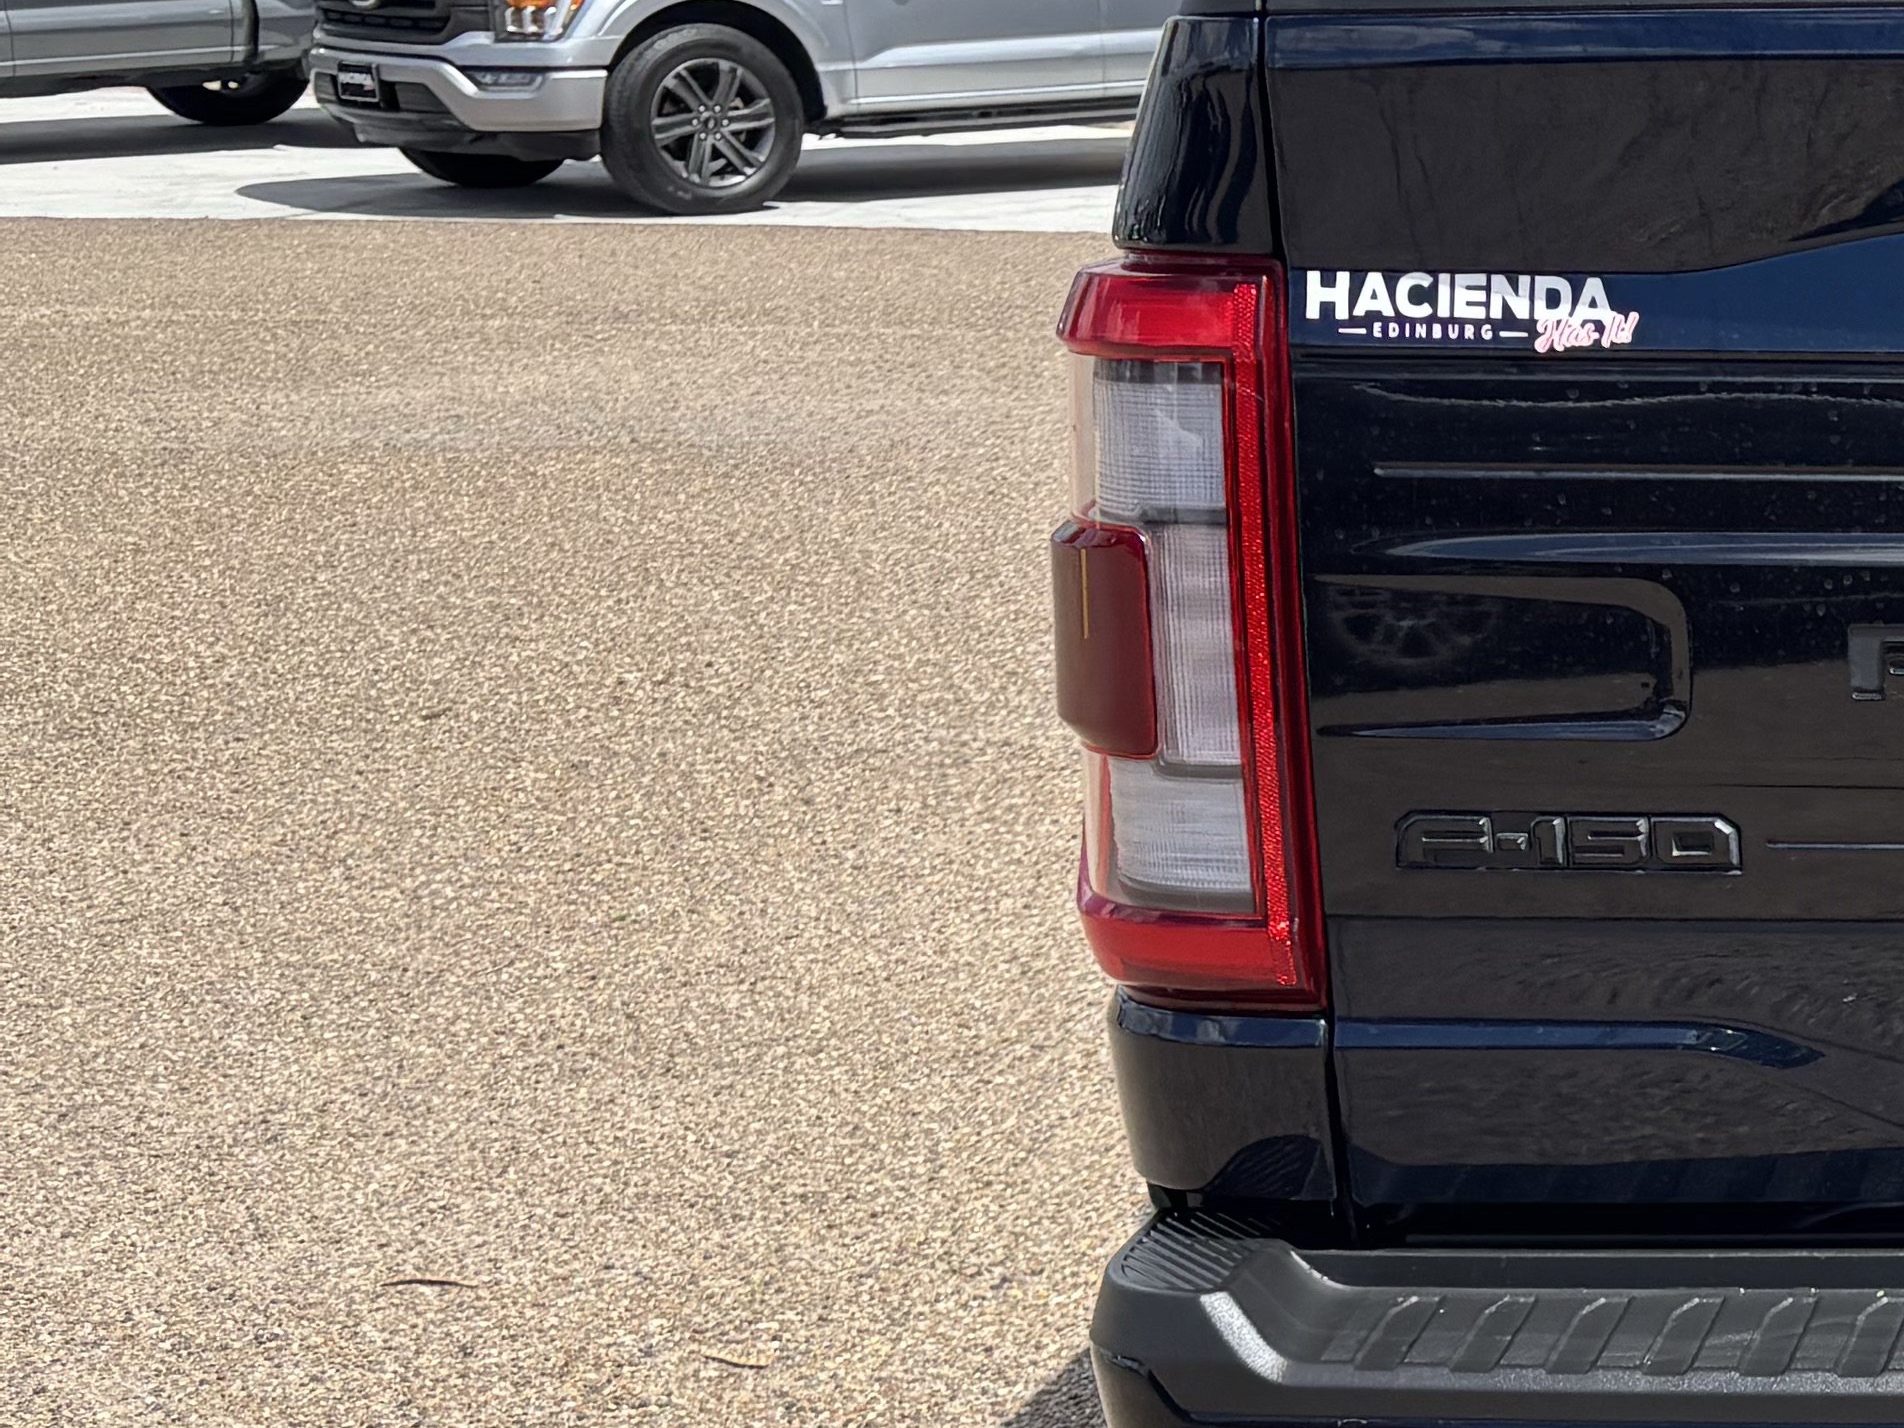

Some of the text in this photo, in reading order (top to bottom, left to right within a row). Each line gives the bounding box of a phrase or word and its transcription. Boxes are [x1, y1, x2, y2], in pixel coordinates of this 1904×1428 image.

[1306, 270, 1617, 322] HACIENDA
[1373, 322, 1493, 340] EDINBURG
[1396, 810, 1743, 875] F-150
